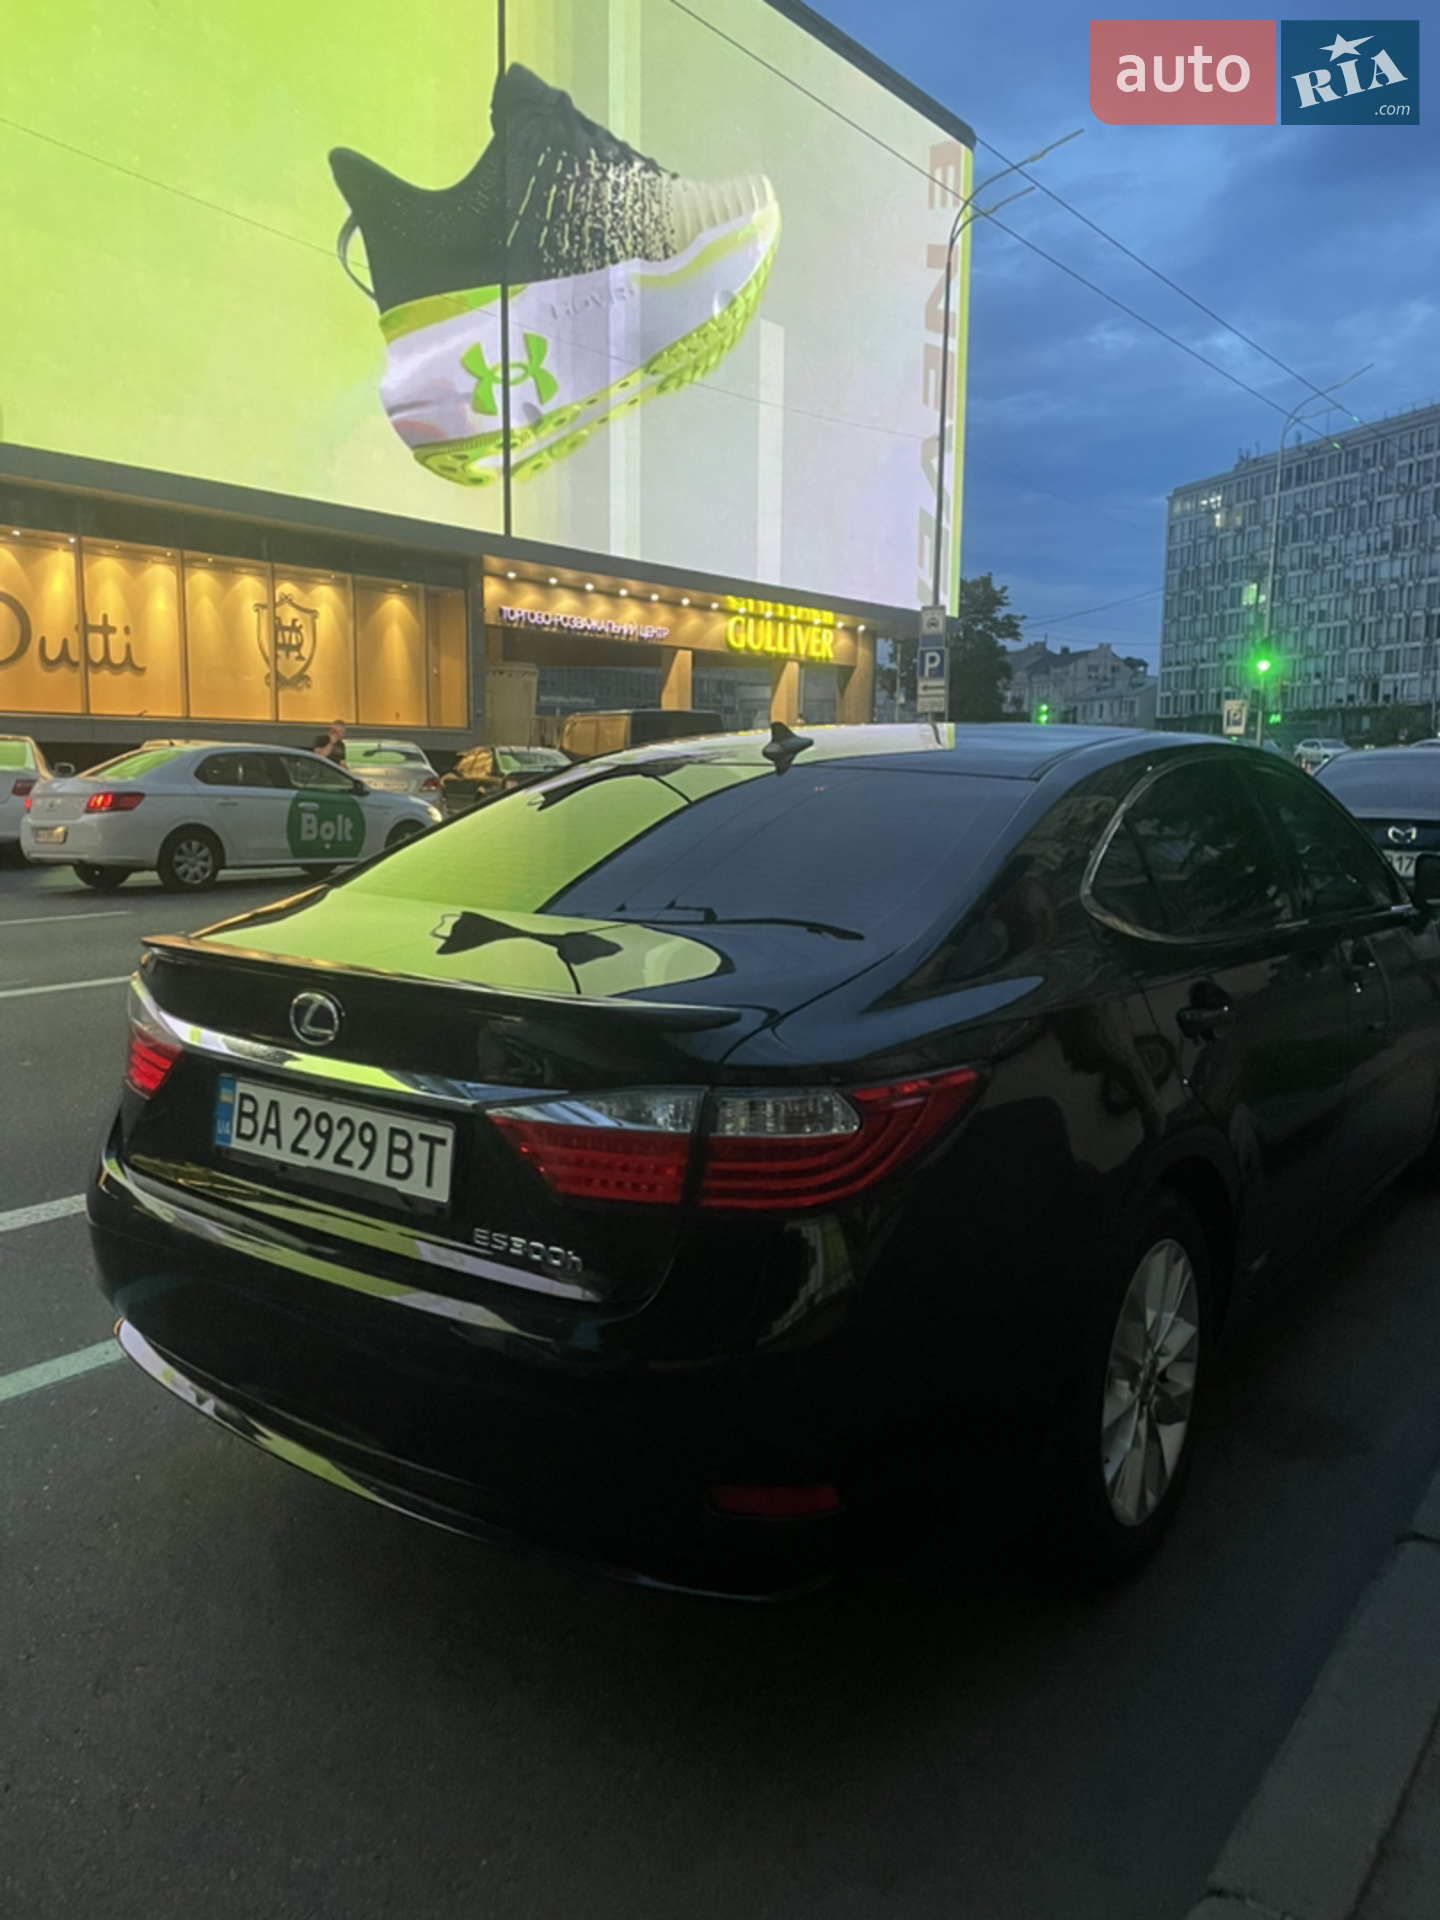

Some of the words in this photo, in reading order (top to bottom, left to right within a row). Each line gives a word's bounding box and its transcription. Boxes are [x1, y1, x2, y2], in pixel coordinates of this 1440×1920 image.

[916, 243, 959, 612] NEVE
[725, 614, 836, 660] GULLIVER
[924, 652, 941, 677] P
[300, 812, 354, 842] Bolt
[236, 1093, 283, 1150] BA
[290, 1106, 378, 1172] 2929
[386, 1127, 447, 1188] BT
[474, 1228, 583, 1271] ES300h
